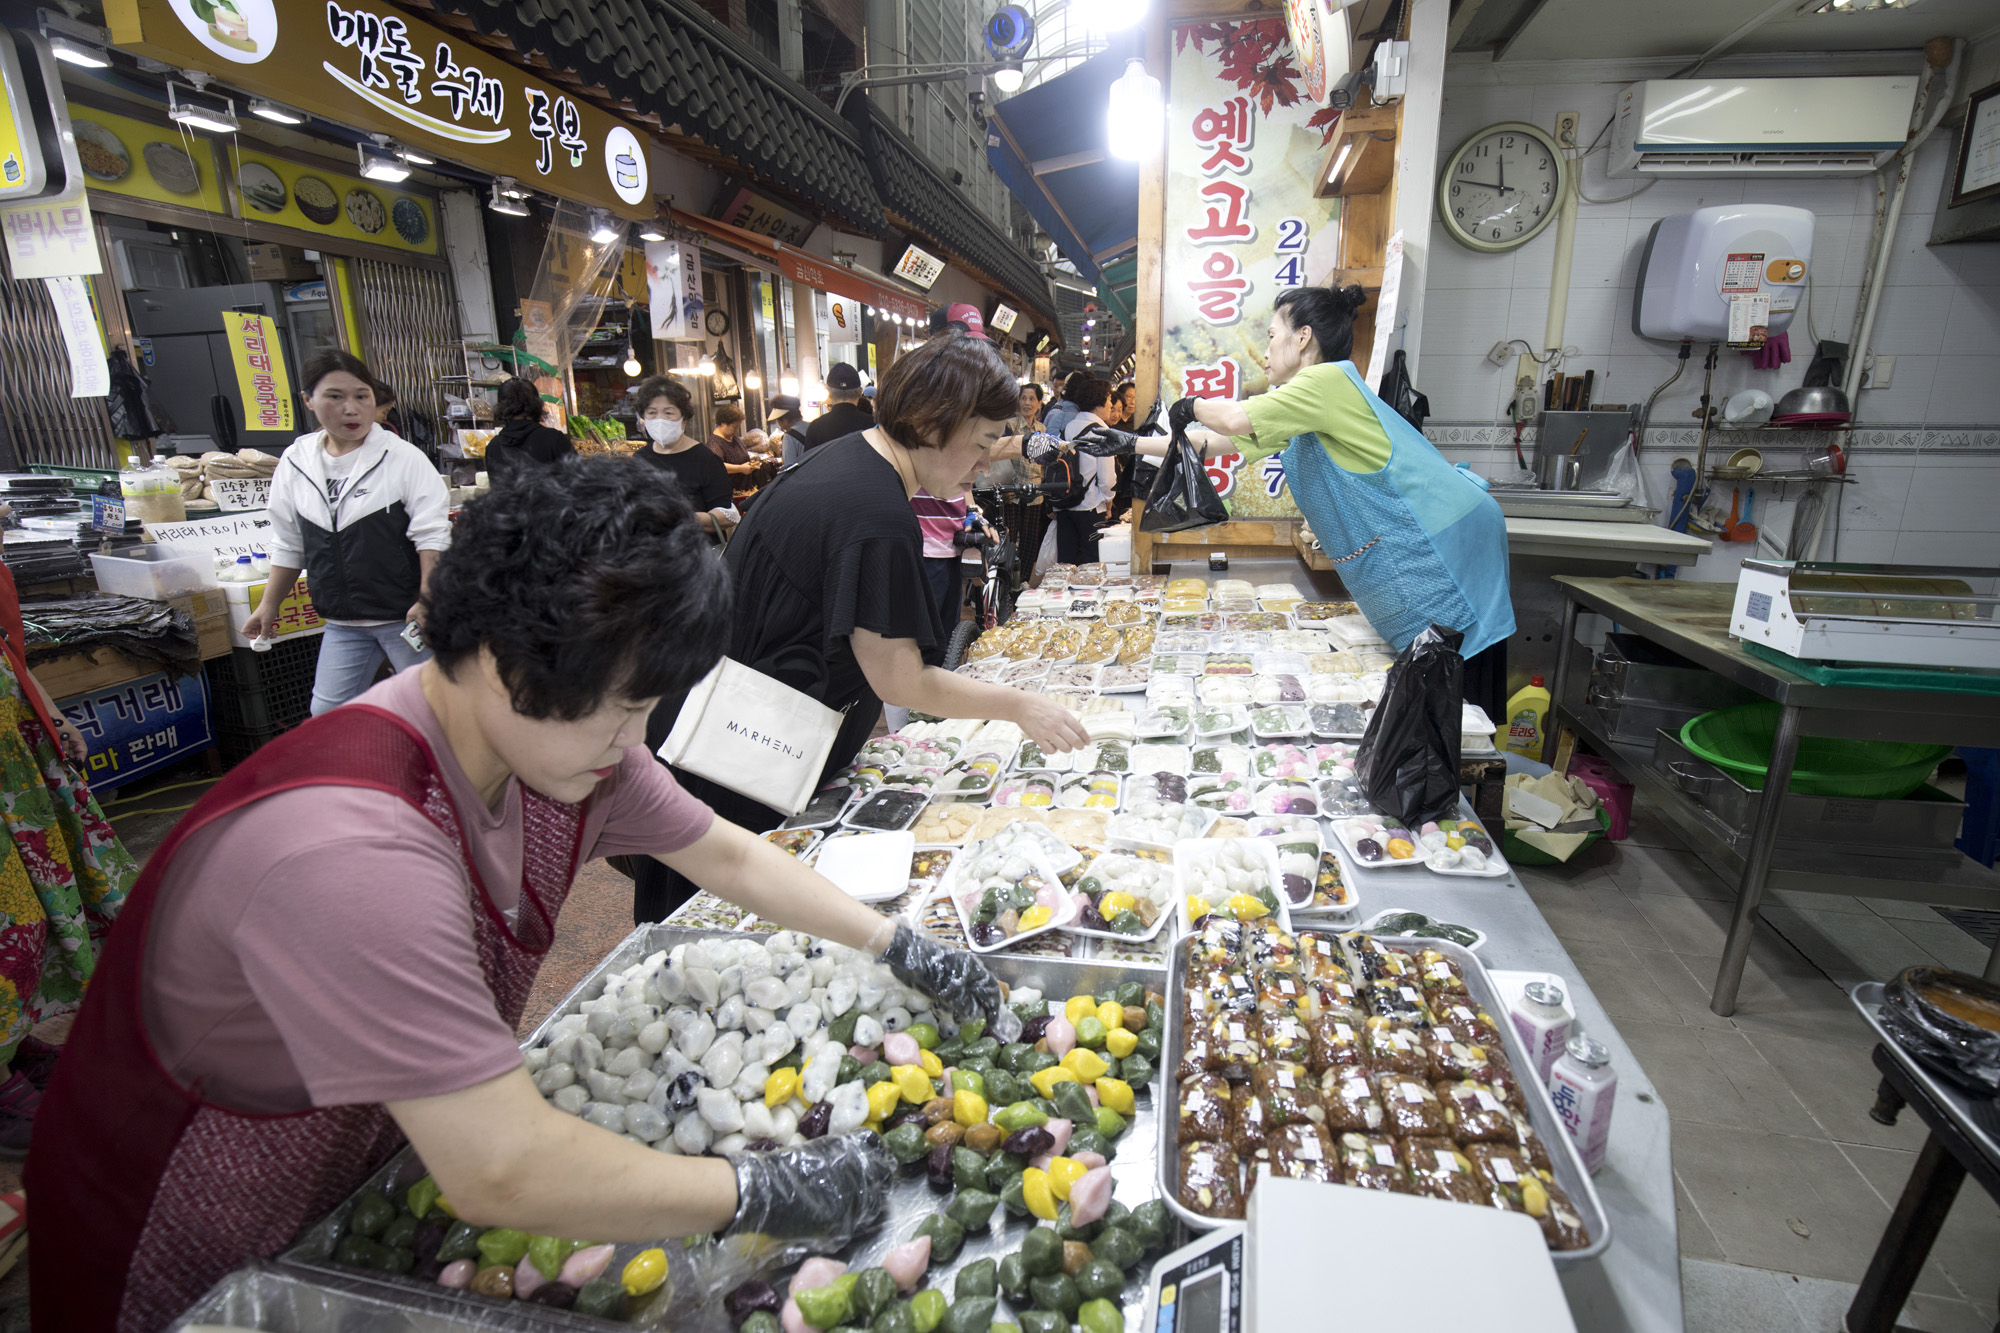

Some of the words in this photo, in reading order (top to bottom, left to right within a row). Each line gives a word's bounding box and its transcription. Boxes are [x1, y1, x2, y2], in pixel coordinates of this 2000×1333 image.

[327, 2, 425, 104] 맷돌
[431, 43, 504, 124] 수제
[525, 87, 587, 174] 두부
[1499, 137, 1514, 149] 12
[1524, 143, 1529, 155] 1
[1475, 145, 1488, 157] 11
[1460, 162, 1474, 174] 10
[1539, 159, 1547, 170] 2
[1452, 185, 1461, 197] 9
[1542, 182, 1550, 194] 3
[1186, 96, 1253, 321] 옛고을
[1456, 207, 1465, 218] 8
[1533, 205, 1541, 216] 4
[1472, 223, 1479, 234] 7
[1515, 221, 1523, 233] 5
[1492, 228, 1501, 239] 6
[685, 253, 698, 329] 금산인삼
[219, 480, 249, 493] 고소한
[155, 527, 197, 542] 서리태
[1508, 727, 1537, 738] 트리오
[128, 725, 178, 762] 판매
[727, 720, 803, 759] MARHEN.J
